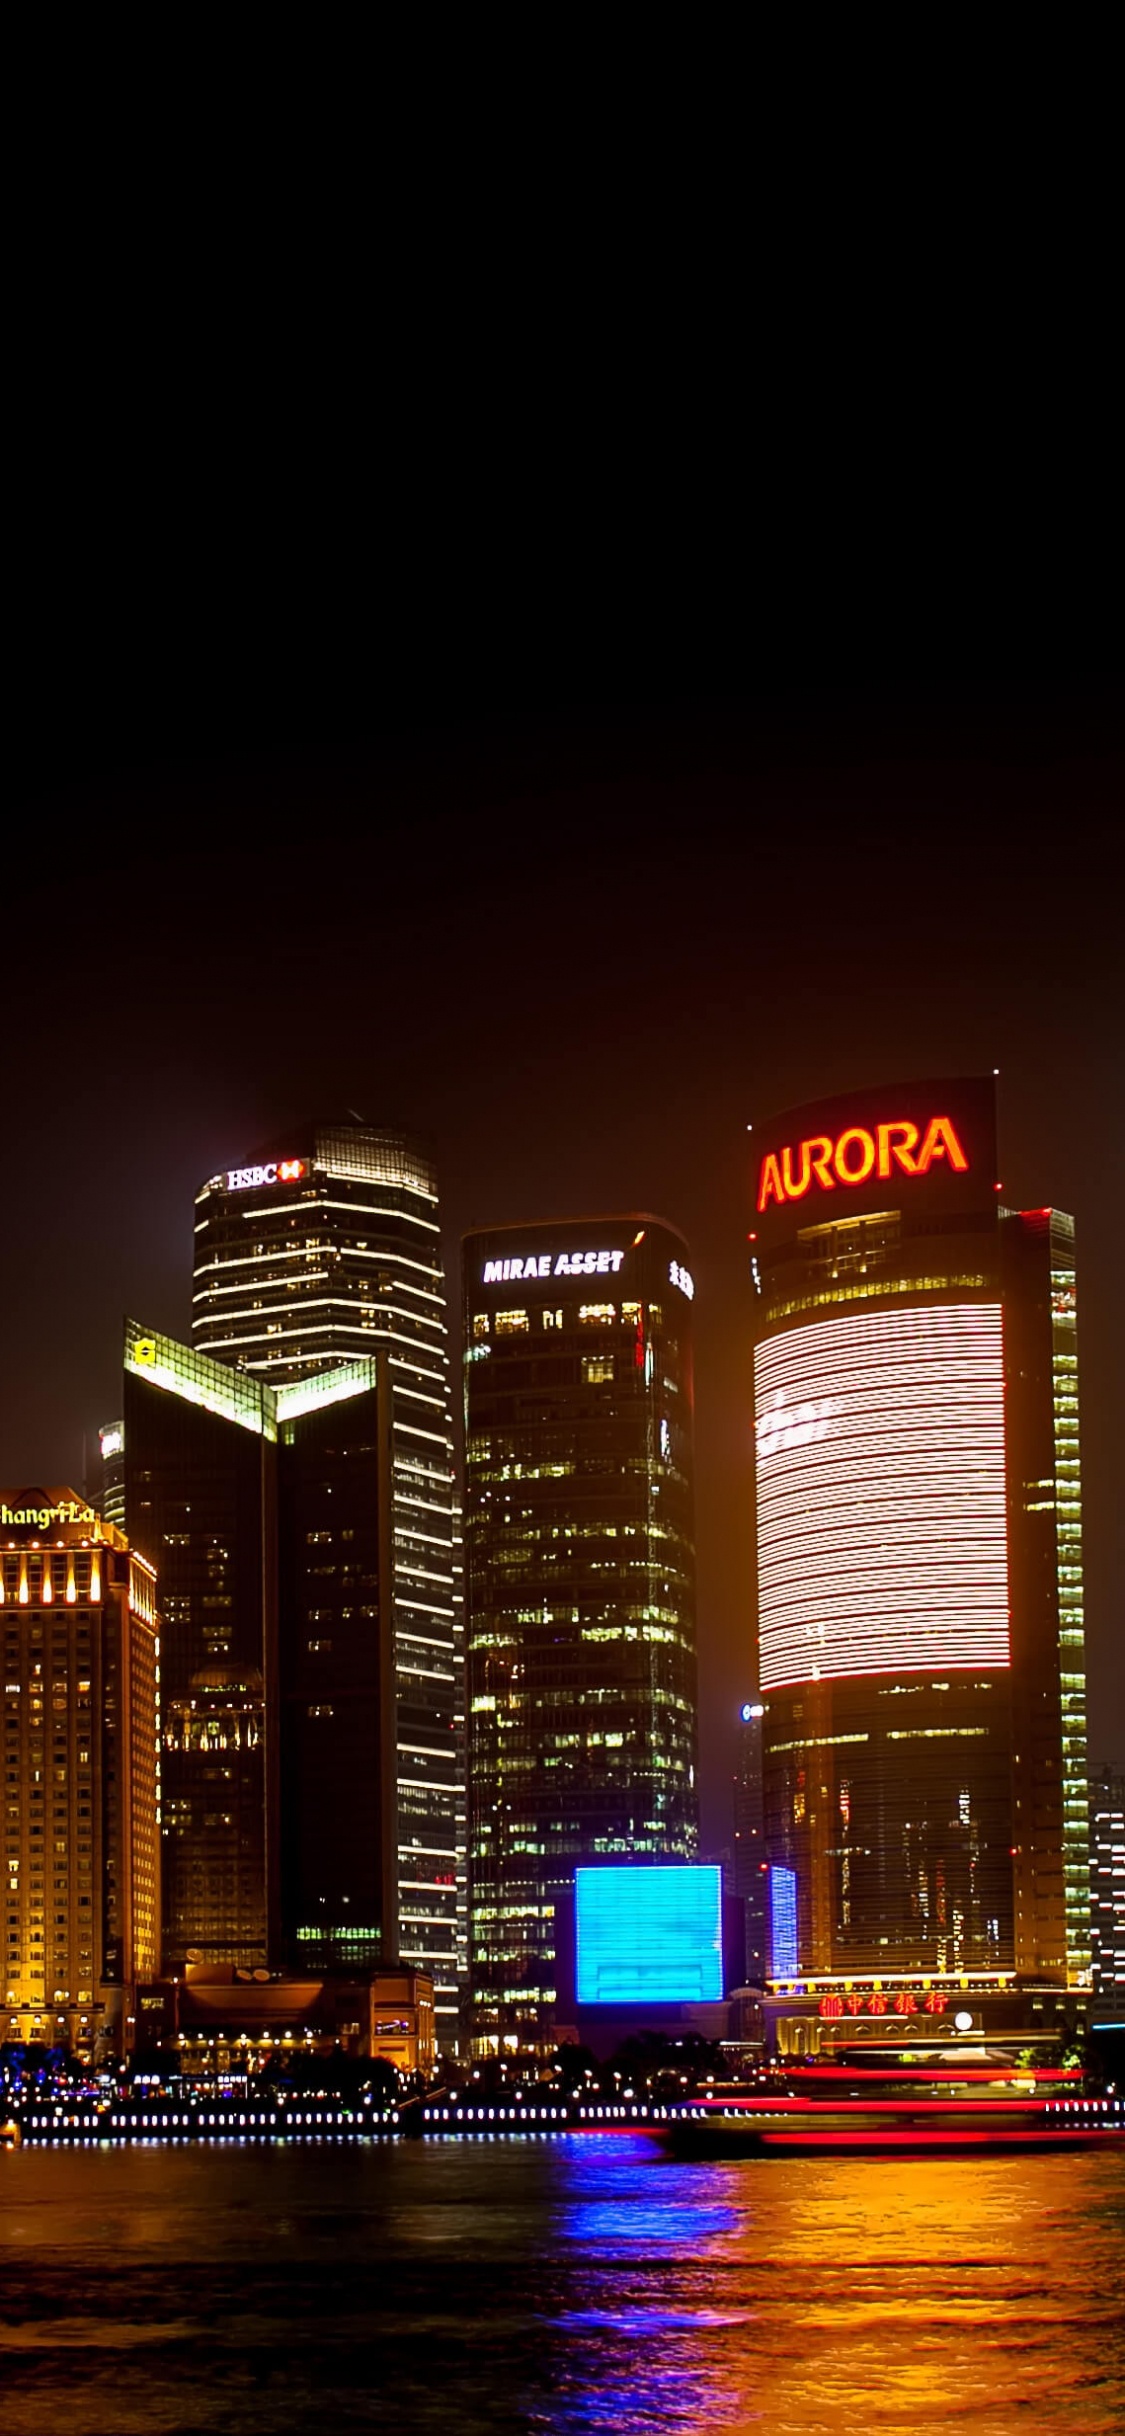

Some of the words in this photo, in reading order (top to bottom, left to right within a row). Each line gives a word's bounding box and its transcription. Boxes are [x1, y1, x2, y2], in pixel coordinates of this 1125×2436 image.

[227, 1163, 278, 1191] HSBC
[757, 1116, 969, 1212] AURORA
[483, 1255, 552, 1283] MIRAE
[553, 1250, 625, 1276] ASSET
[0, 1501, 95, 1530] hangri-La
